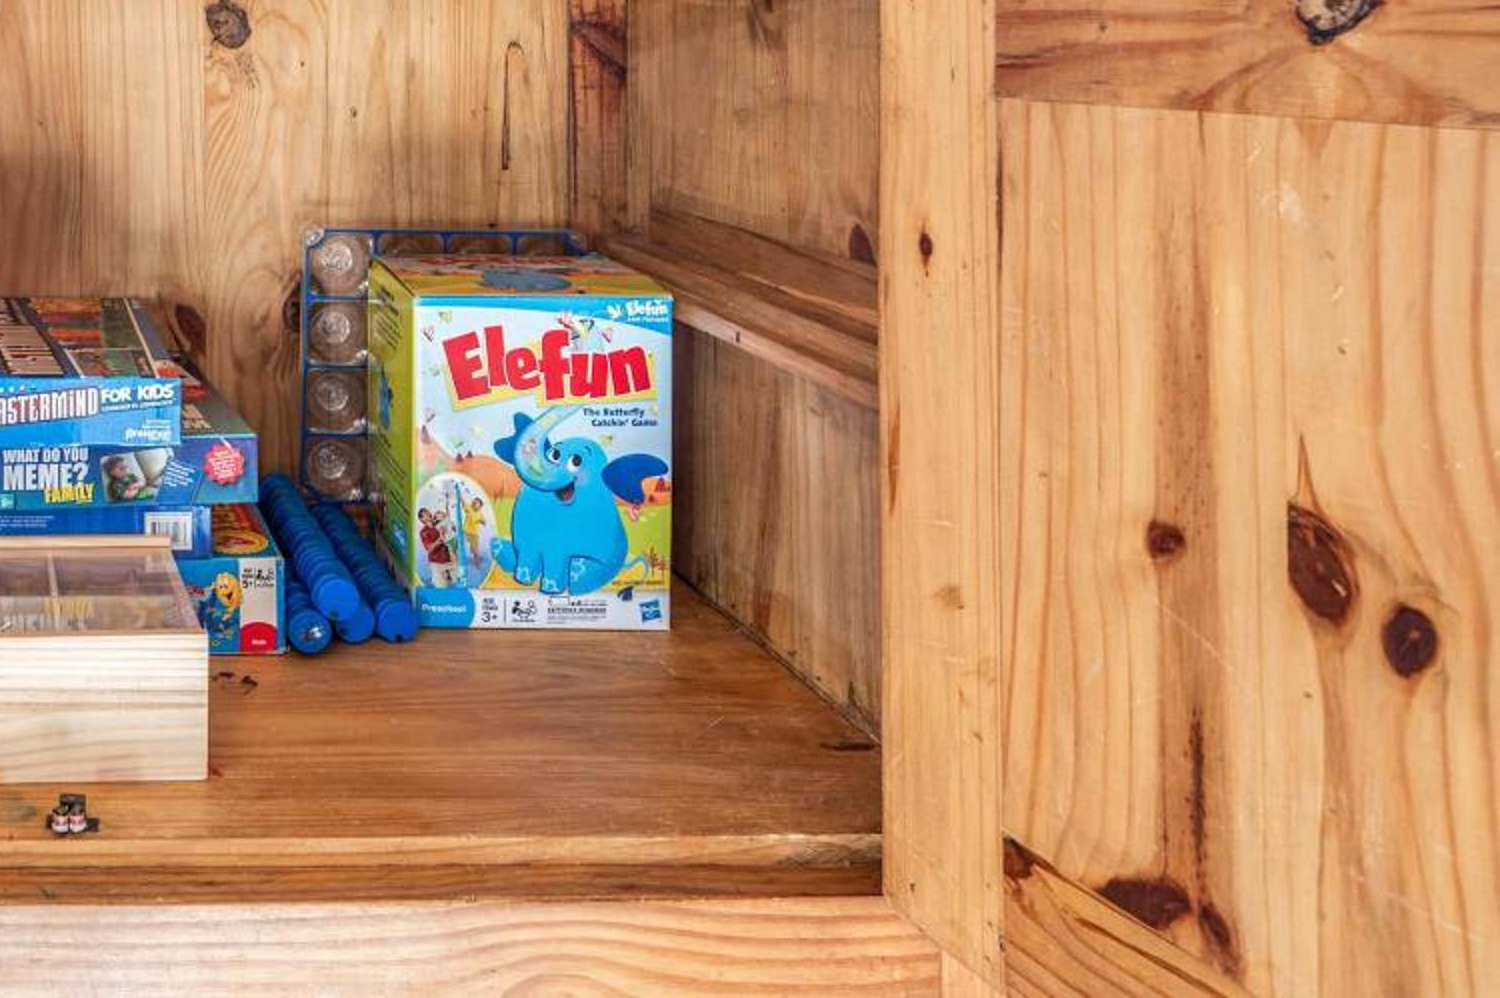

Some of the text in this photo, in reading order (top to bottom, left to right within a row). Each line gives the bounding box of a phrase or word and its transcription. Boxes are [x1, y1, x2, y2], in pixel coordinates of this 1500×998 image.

[443, 325, 651, 401] Elefun
[101, 388, 132, 403] FOR
[138, 384, 175, 400] KIDS
[583, 406, 645, 418] The Butterfly
[631, 418, 657, 427] Game
[3, 447, 89, 463] WHAT DO YOU
[3, 462, 89, 491] MEME?
[44, 484, 94, 505] FAMILY
[420, 603, 466, 614] Preschool
[481, 612, 498, 623] 3+
